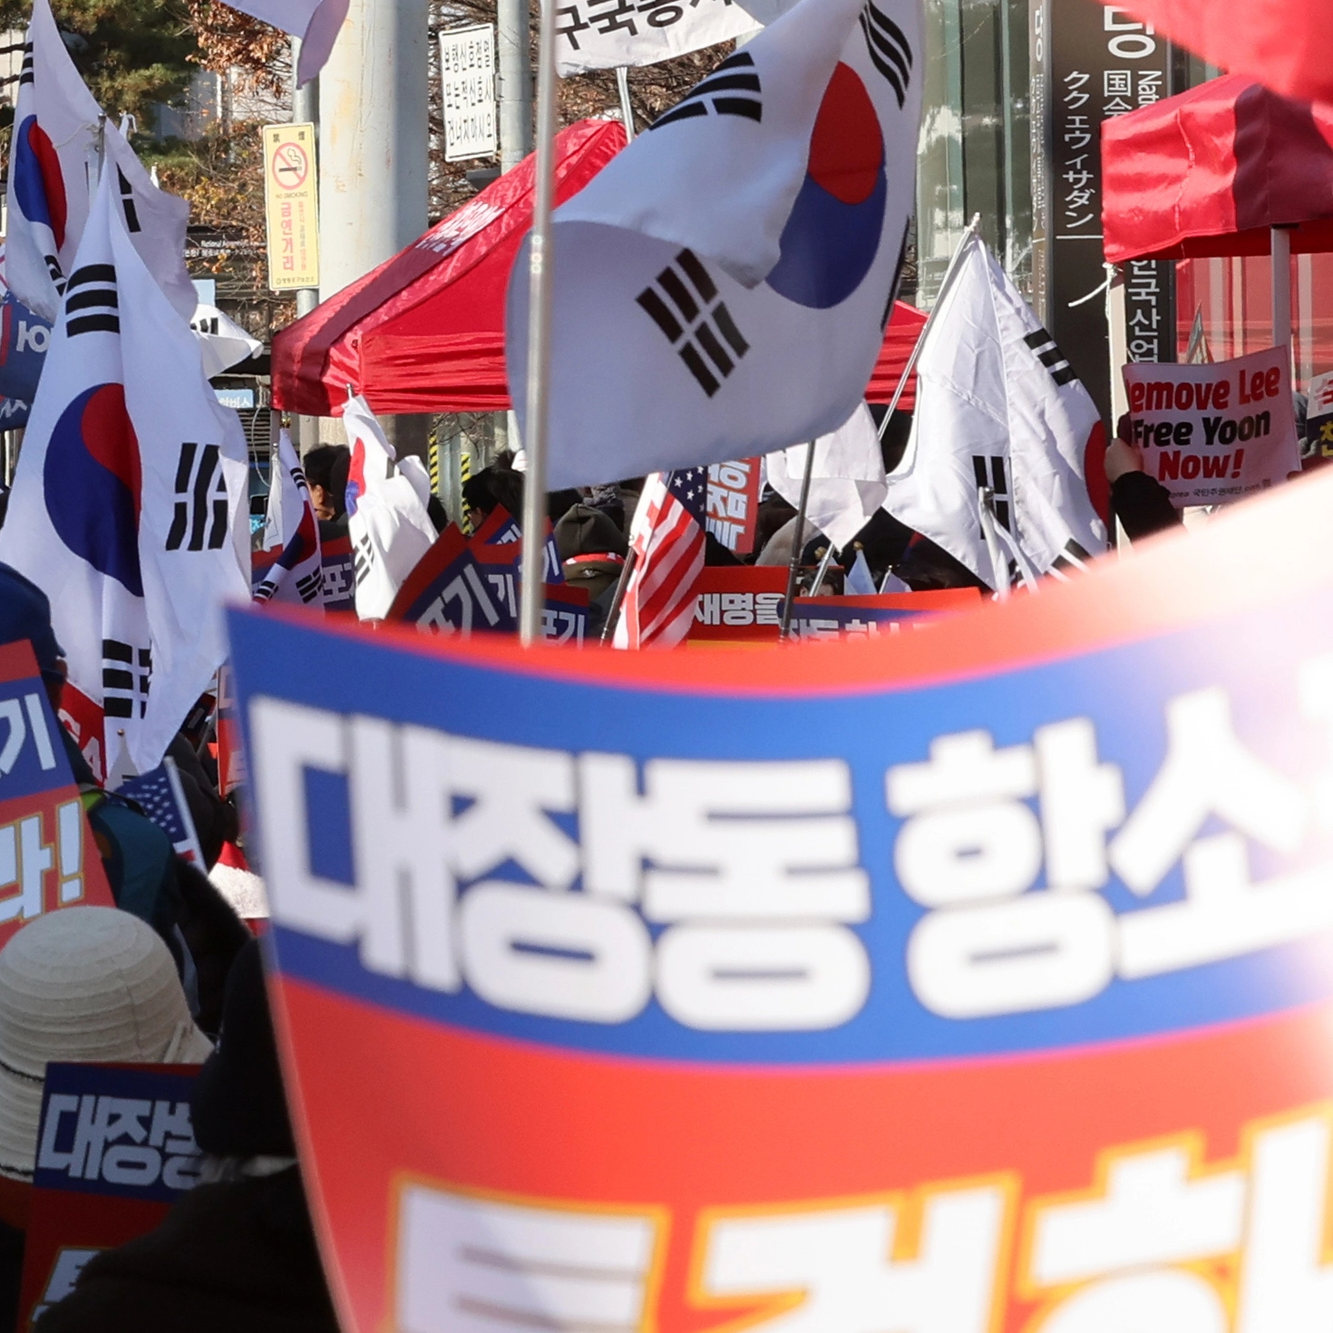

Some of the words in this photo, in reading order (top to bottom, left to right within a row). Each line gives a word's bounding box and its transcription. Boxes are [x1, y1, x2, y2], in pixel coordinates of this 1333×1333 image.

[280, 202, 294, 271] 금연거리
[1127, 378, 1229, 413] emove
[1238, 367, 1281, 405] Lee
[1202, 410, 1271, 446] Yoon
[1158, 449, 1244, 482] Now!
[247, 695, 872, 1032] 대장동
